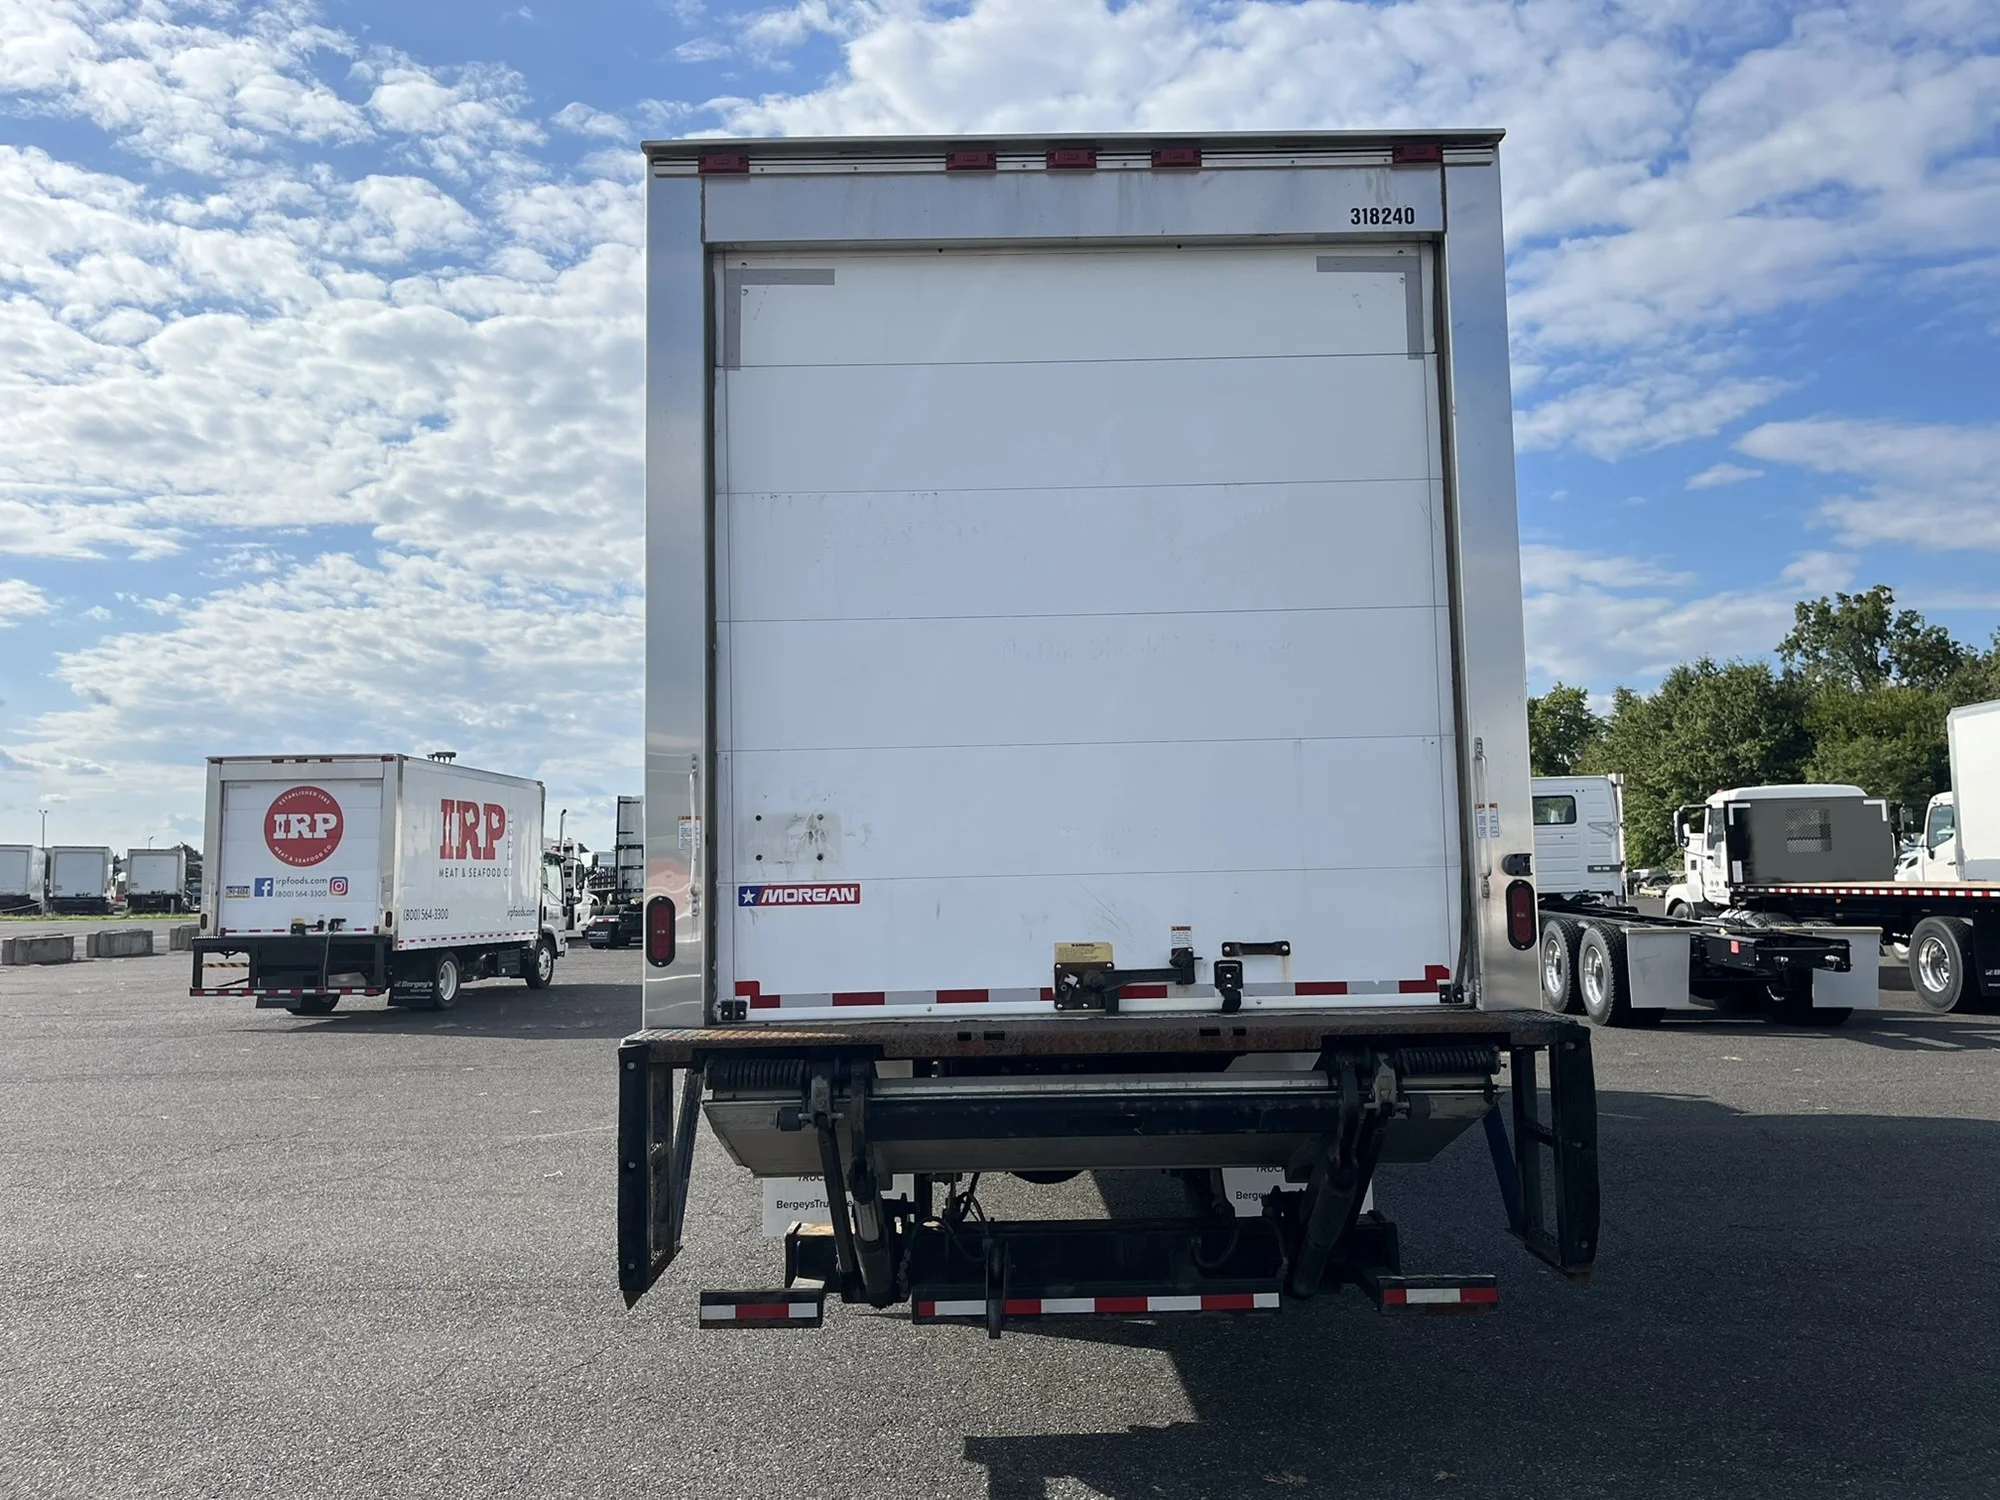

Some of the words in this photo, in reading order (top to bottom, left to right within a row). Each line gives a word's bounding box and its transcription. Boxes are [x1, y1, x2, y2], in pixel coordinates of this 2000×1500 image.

[1350, 207, 1415, 225] 318240
[278, 790, 317, 805] ESTABLISHED
[273, 813, 338, 839] IRP
[440, 798, 506, 860] IRP
[274, 845, 289, 859] MEAT
[295, 852, 324, 863] SEAFOOD
[323, 844, 332, 853] CO
[438, 867, 458, 878] MEAT
[462, 867, 466, 878] &
[469, 867, 501, 878] SEAFOOD
[503, 867, 512, 878] CO
[275, 876, 328, 887] irpfoods.com
[275, 890, 294, 898] (800)
[295, 890, 327, 898] 564-3300
[761, 887, 855, 904] MORGAN
[403, 908, 421, 921] (800)
[421, 908, 449, 920] 564-3300
[507, 905, 536, 921] irpfoods.com
